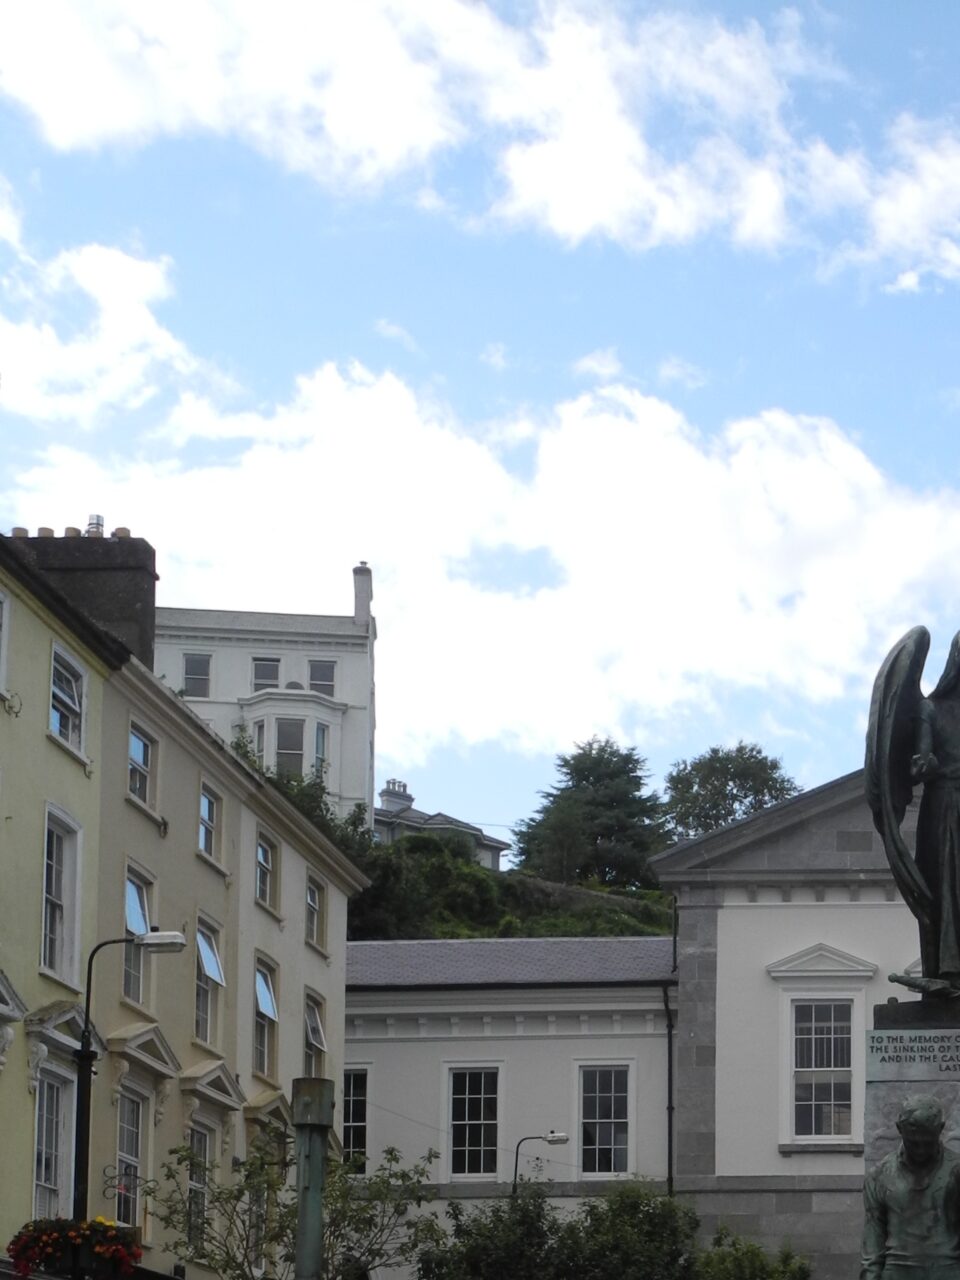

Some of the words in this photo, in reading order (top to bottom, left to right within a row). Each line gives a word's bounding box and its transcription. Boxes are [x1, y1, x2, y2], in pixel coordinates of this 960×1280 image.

[870, 1036, 884, 1044] TO
[886, 1036, 904, 1044] THE
[909, 1035, 952, 1044] MEMORY
[869, 1045, 889, 1053] THE
[893, 1045, 935, 1053] SINKING
[938, 1045, 952, 1053] OF
[879, 1055, 902, 1063] AND
[904, 1055, 916, 1063] IN
[919, 1055, 938, 1063] THE
